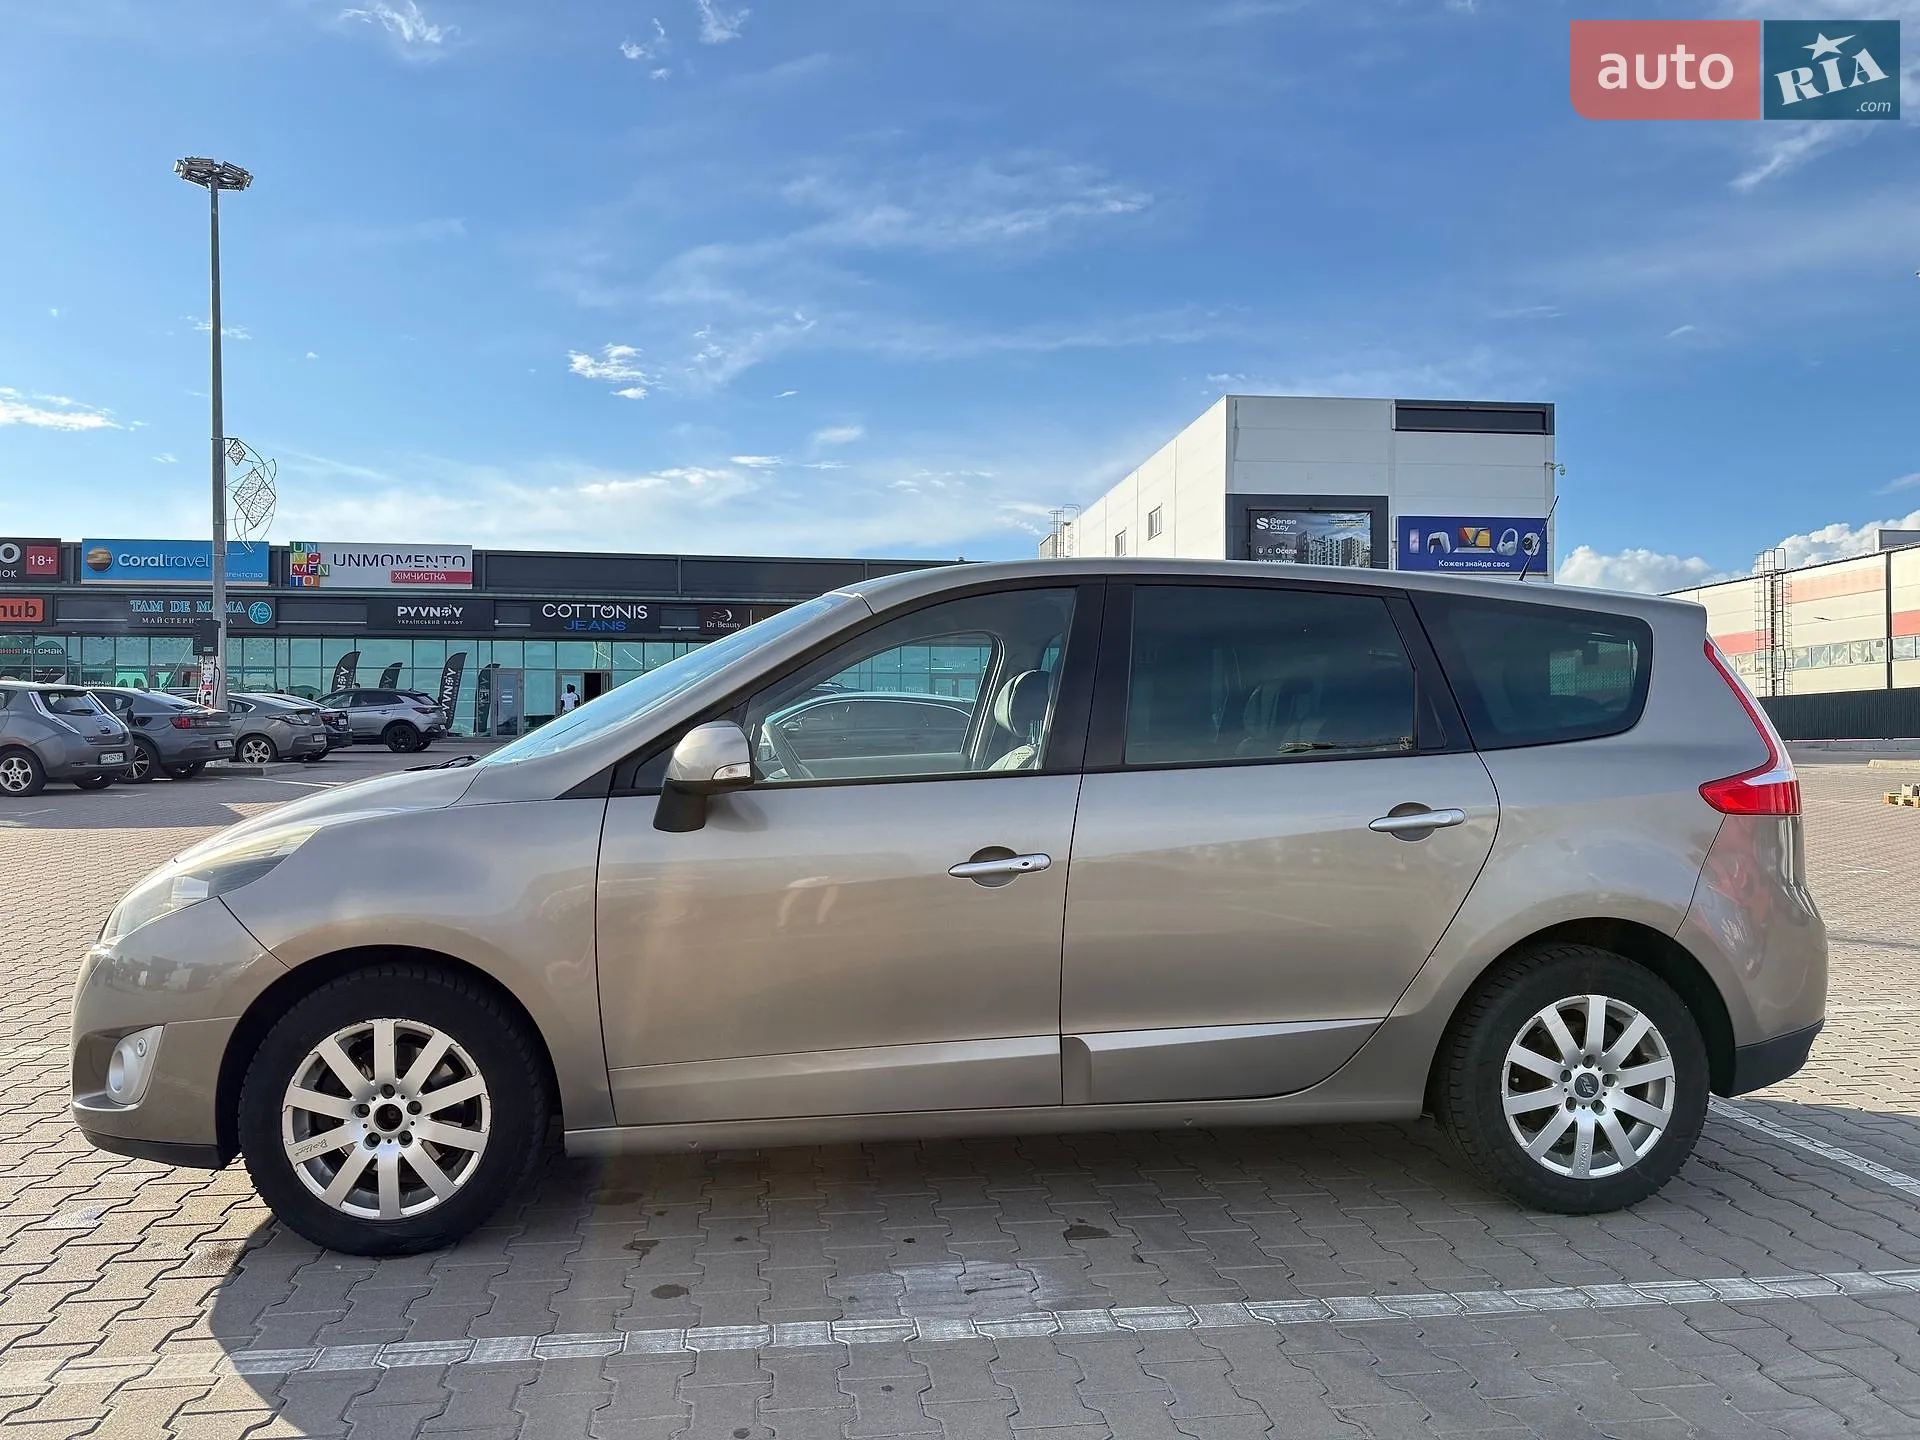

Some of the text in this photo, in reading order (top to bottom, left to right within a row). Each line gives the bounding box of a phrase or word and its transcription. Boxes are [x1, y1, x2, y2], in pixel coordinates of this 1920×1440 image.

[1270, 524, 1290, 532] City
[29, 555, 54, 566] 18+
[333, 553, 466, 569] UNMOMENTO
[1438, 560, 1465, 568] Кожен
[1465, 560, 1491, 569] знайде
[394, 572, 447, 582] ХІМЧИСТКА
[170, 600, 191, 613] DE
[542, 603, 648, 620] COTTONIS
[142, 616, 200, 625] МАЙСТЕРН
[564, 620, 626, 631] JEANS
[706, 621, 742, 631] Dr Beauty
